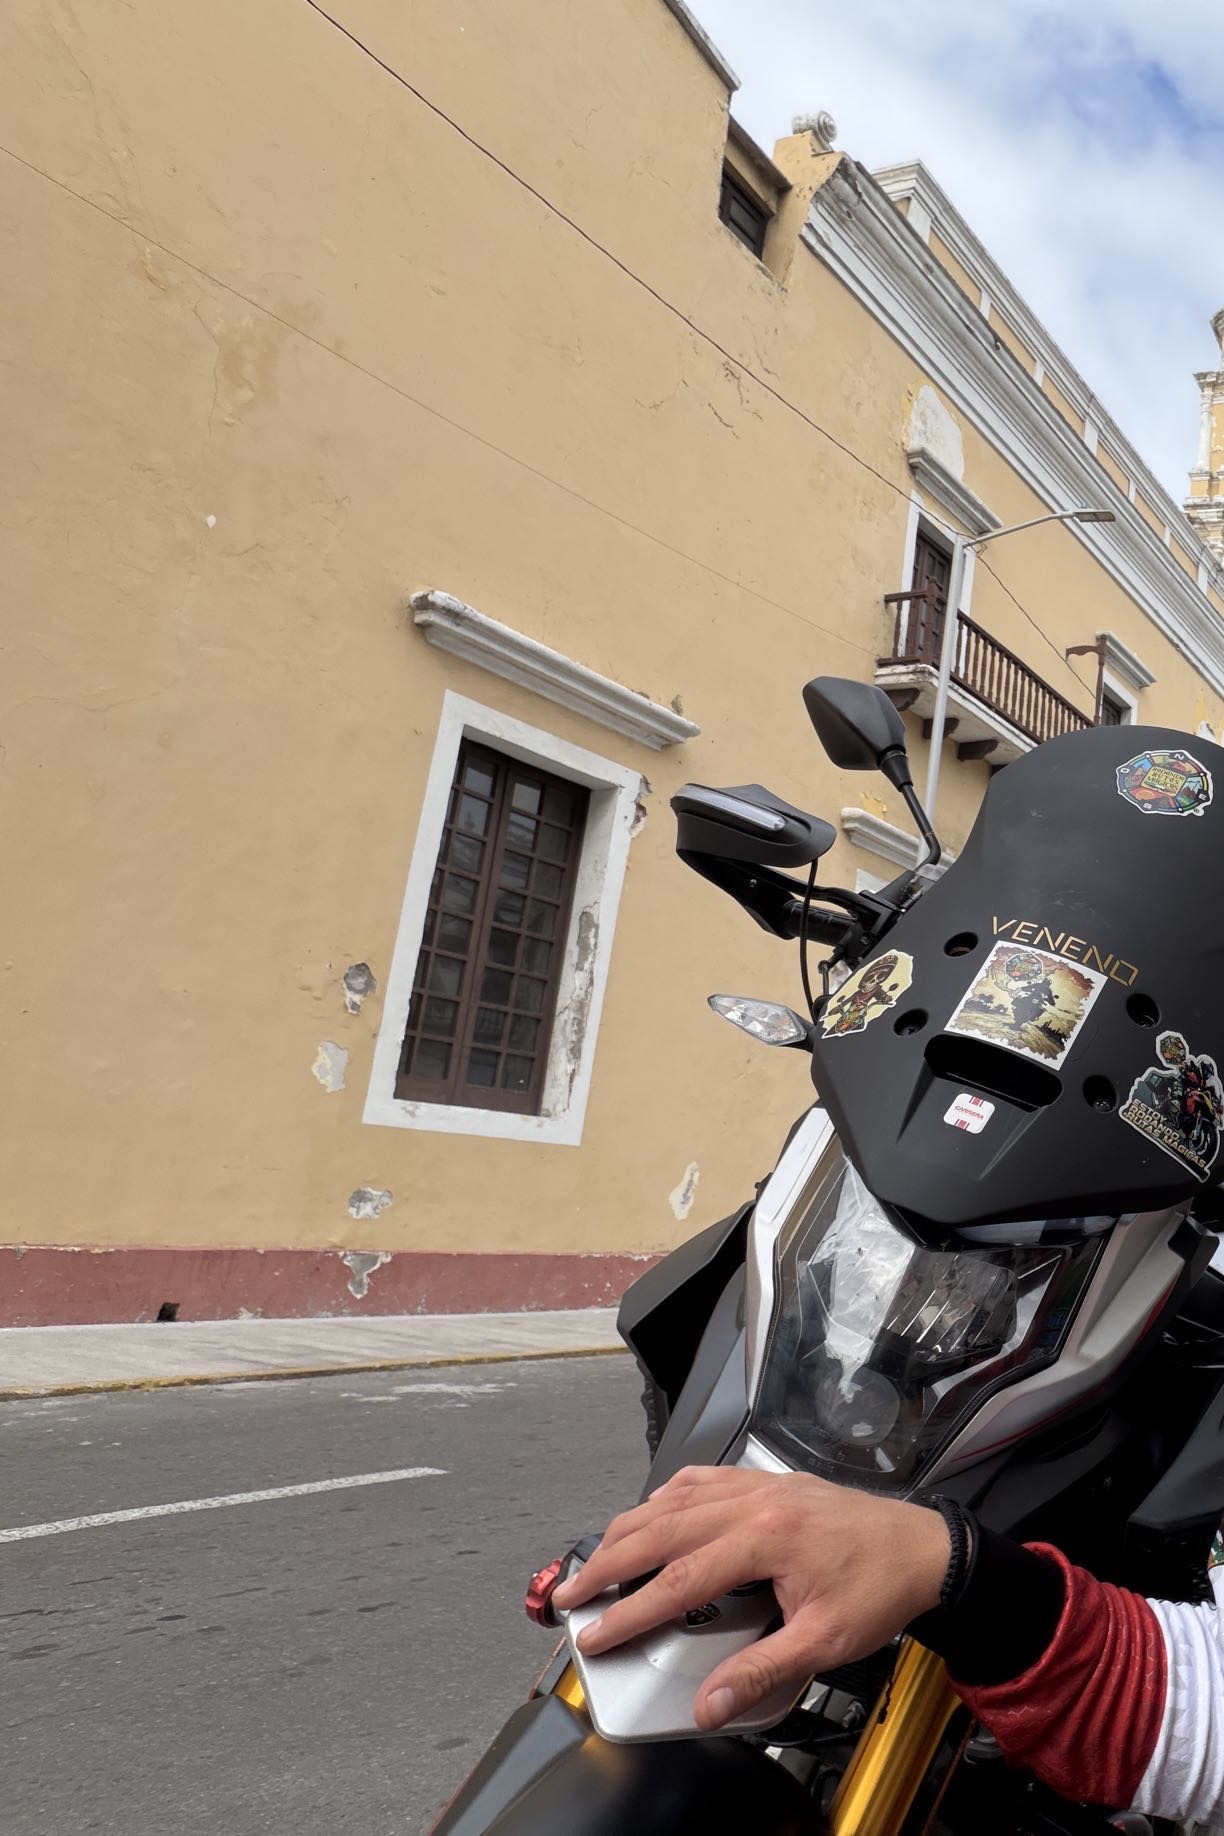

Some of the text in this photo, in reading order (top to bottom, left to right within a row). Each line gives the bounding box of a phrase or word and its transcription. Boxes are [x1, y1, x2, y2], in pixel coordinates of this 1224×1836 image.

[992, 916, 1139, 987] VENENO
[954, 1105, 984, 1120] CARRERA
[1132, 1098, 1167, 1123] ESTOY
[1126, 1111, 1161, 1138] RUTAS
